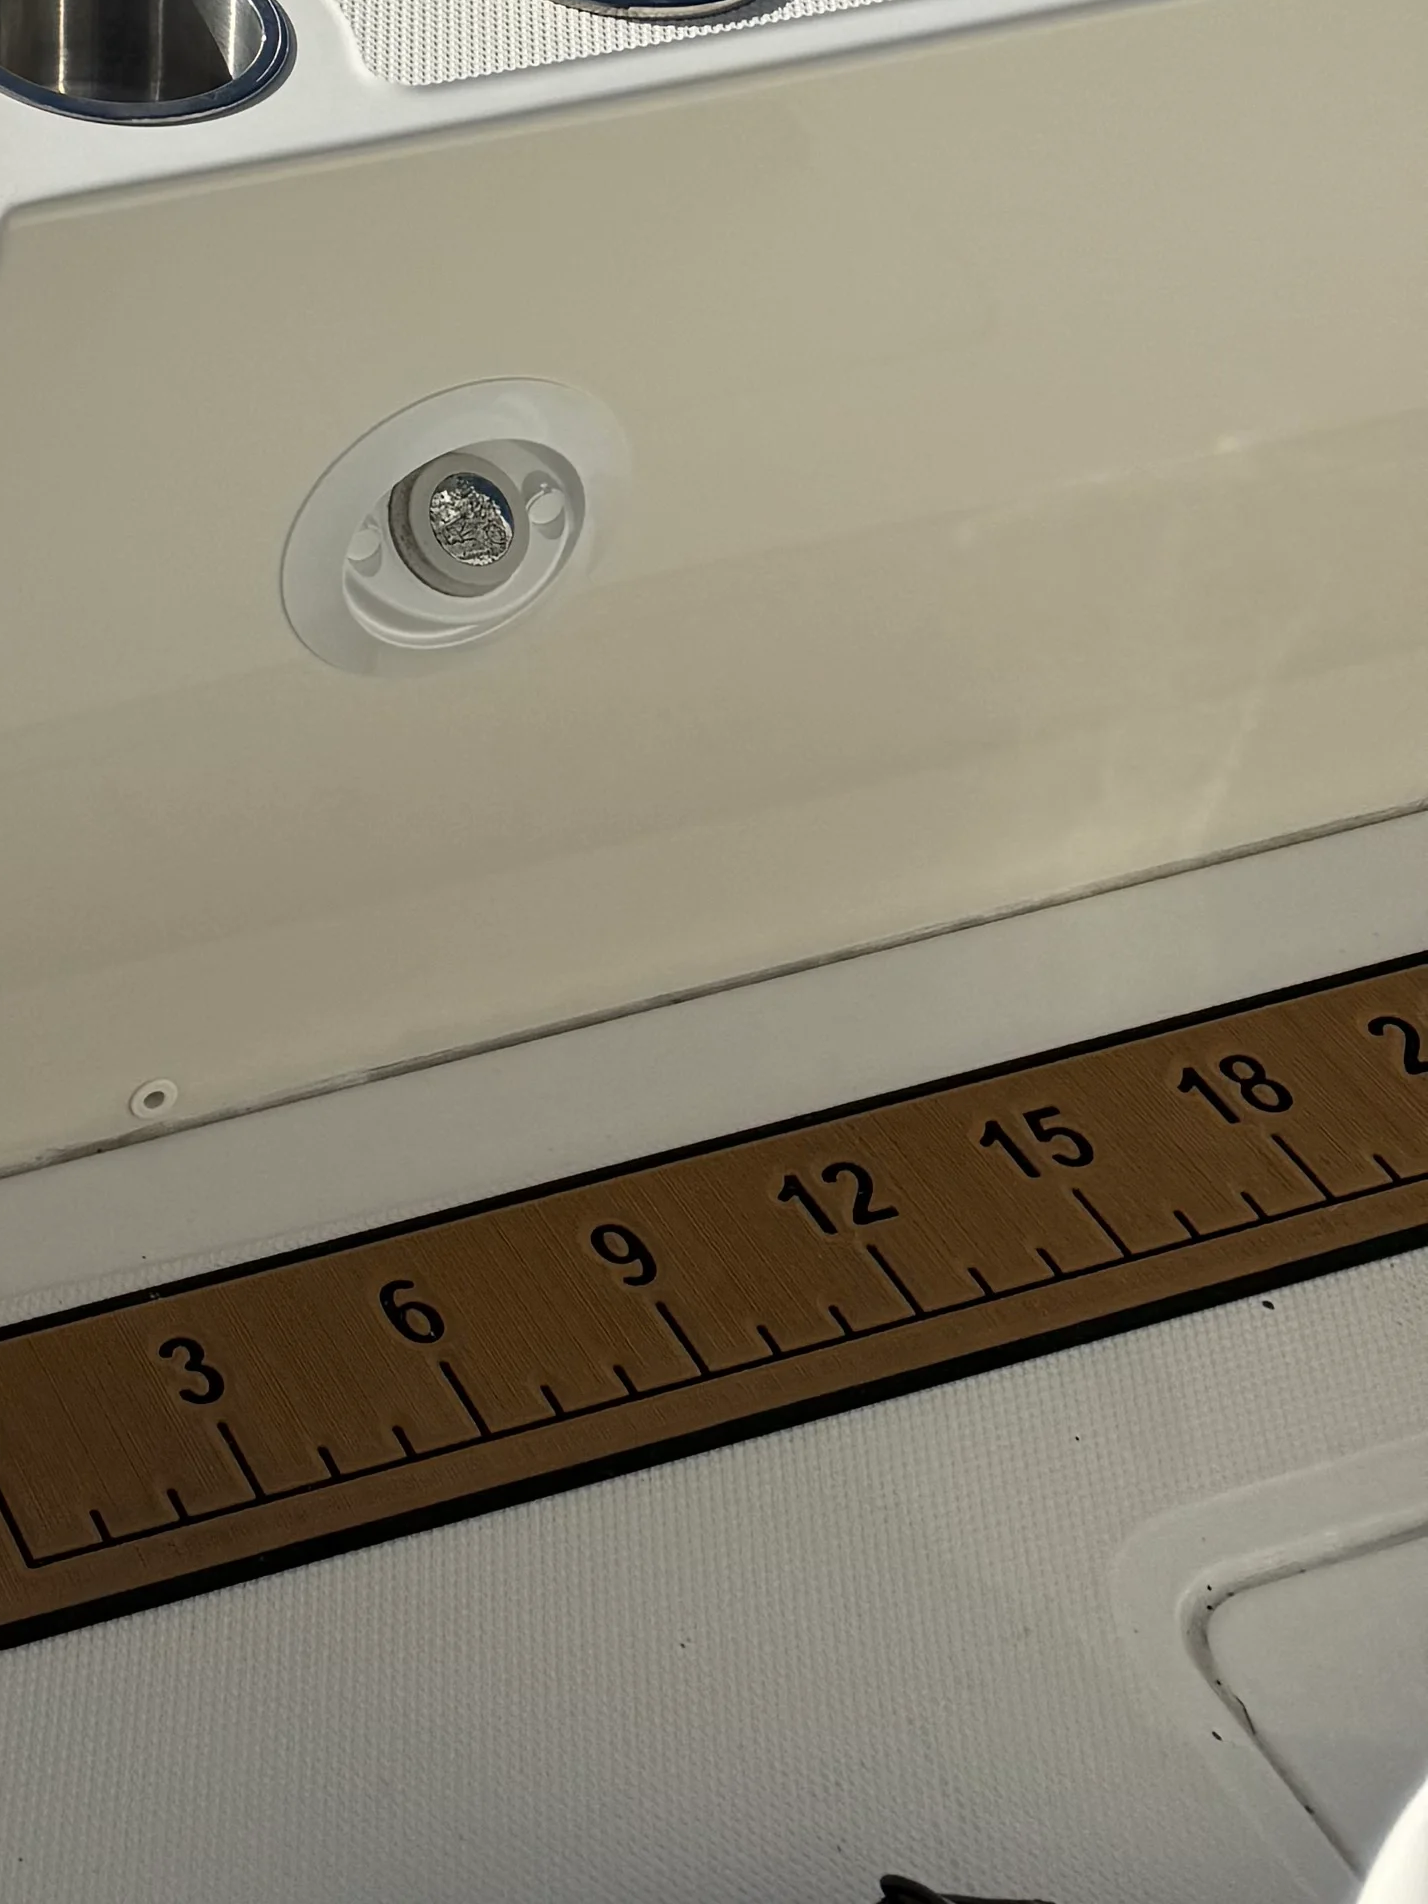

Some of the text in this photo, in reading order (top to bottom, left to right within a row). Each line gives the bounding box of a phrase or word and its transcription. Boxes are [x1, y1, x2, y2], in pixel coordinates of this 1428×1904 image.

[159, 1337, 224, 1404] 3
[380, 1280, 444, 1343] 6
[591, 1224, 657, 1286] 9
[778, 1162, 899, 1235] 12
[980, 1106, 1093, 1178] 15
[1177, 1055, 1293, 1124] 18
[1368, 1017, 1428, 1075] 2
